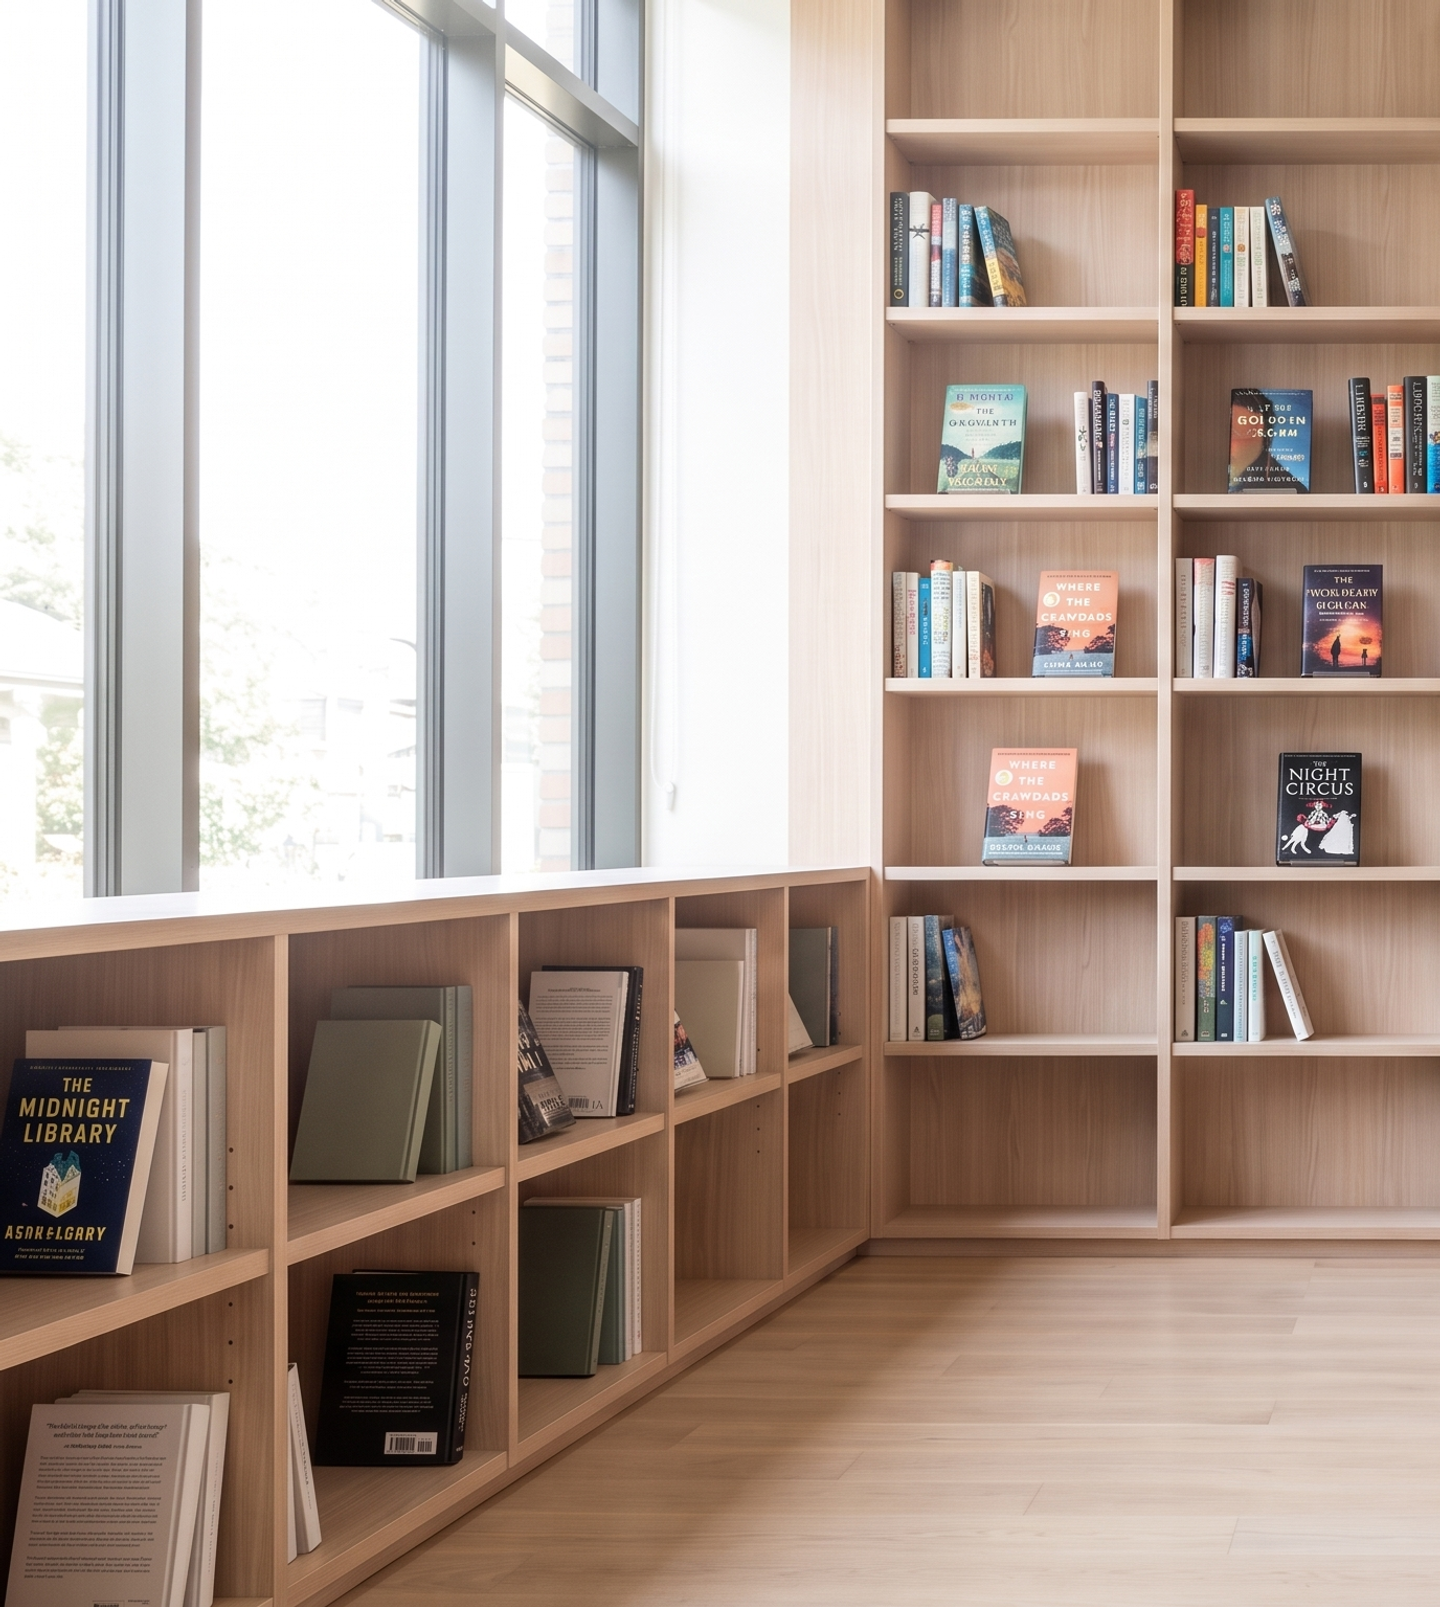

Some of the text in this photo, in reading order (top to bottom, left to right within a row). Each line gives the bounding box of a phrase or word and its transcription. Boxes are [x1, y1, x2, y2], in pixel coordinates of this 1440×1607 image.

[1056, 583, 1101, 591] WHERE
[1066, 598, 1090, 606] THE
[1009, 761, 1056, 769] WHERE
[1289, 768, 1351, 781] NIGHT
[1019, 777, 1044, 785] THE
[1285, 782, 1354, 796] CIRCUS
[993, 792, 1069, 801] CRAWDADS
[1010, 811, 1045, 819] SING
[63, 1078, 92, 1092] THE
[19, 1098, 130, 1118] MIDNIGHT
[23, 1123, 117, 1143] LIBRARY
